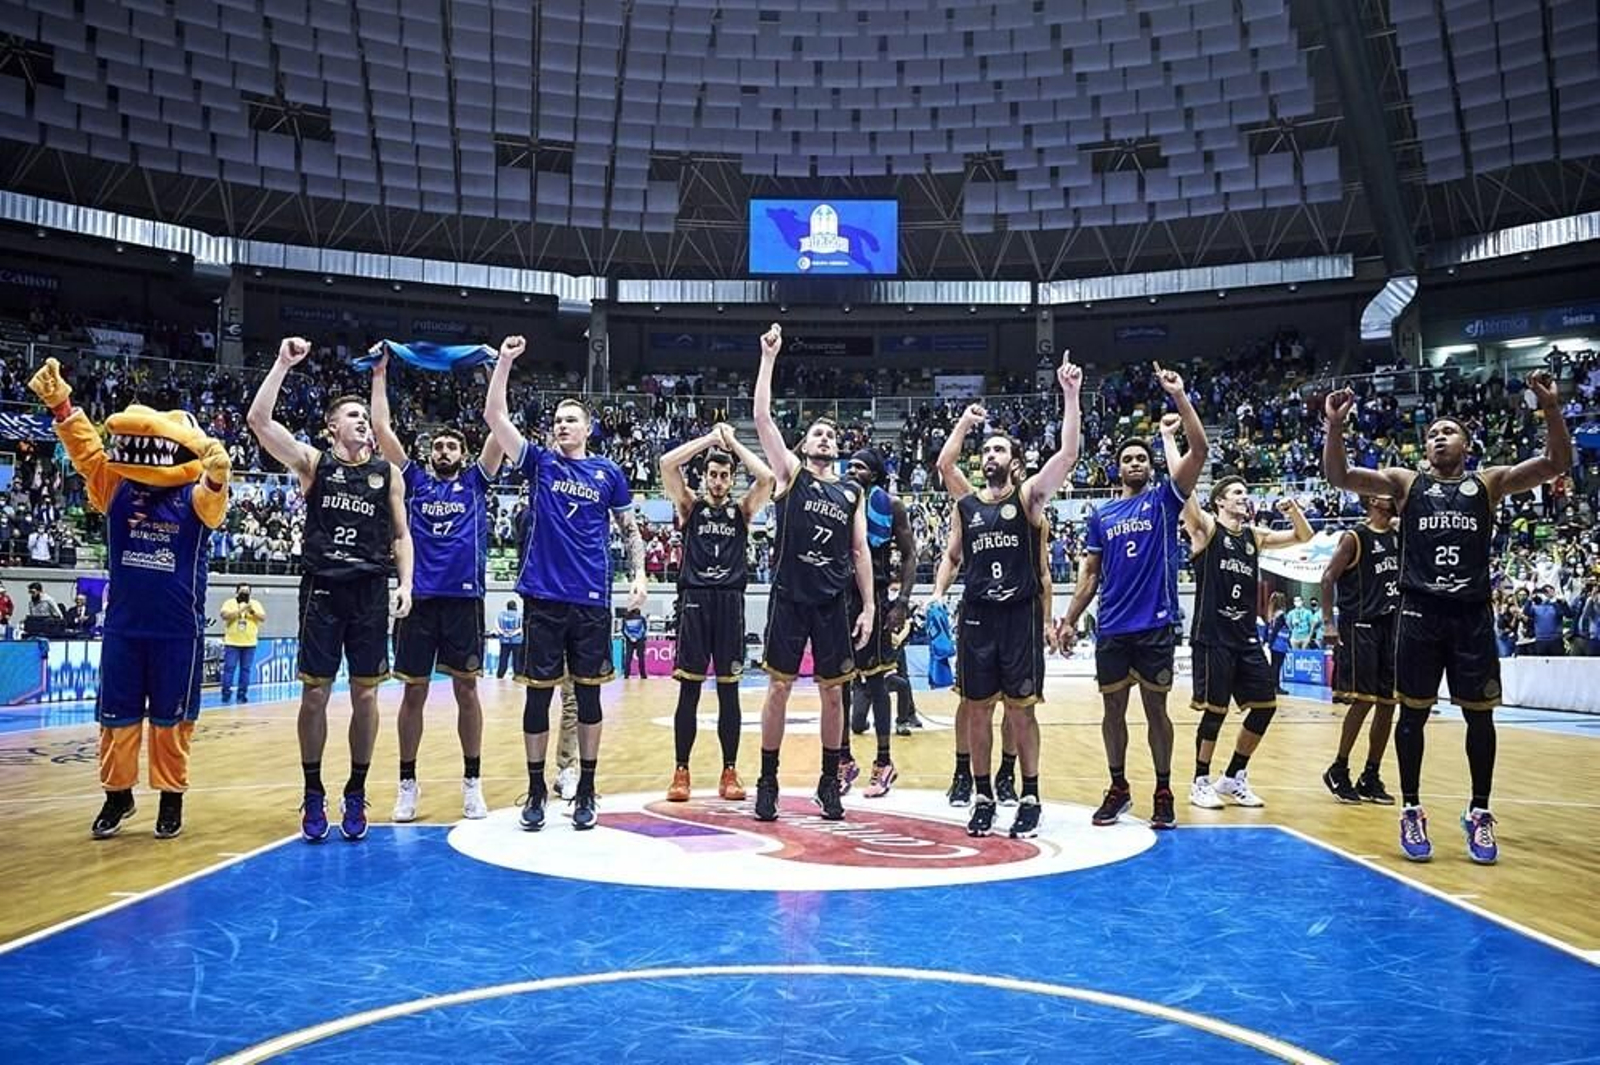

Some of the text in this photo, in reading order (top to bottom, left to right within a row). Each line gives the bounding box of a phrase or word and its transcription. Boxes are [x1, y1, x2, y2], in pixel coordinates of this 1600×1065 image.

[551, 480, 600, 502] BURGOS
[321, 495, 375, 516] BURGOS
[421, 502, 467, 516] BURGOS
[566, 501, 579, 519] 7
[804, 500, 849, 525] BURGOS
[432, 521, 453, 536] 27
[1106, 519, 1153, 541] BURGOS
[1418, 516, 1478, 531] BURGOS
[130, 529, 171, 543] BURGOS
[333, 526, 357, 547] 22
[812, 525, 833, 545] 77
[1126, 540, 1137, 558] 2
[1434, 546, 1461, 566] 25
[990, 561, 1002, 579] 8
[1231, 584, 1242, 599] 6
